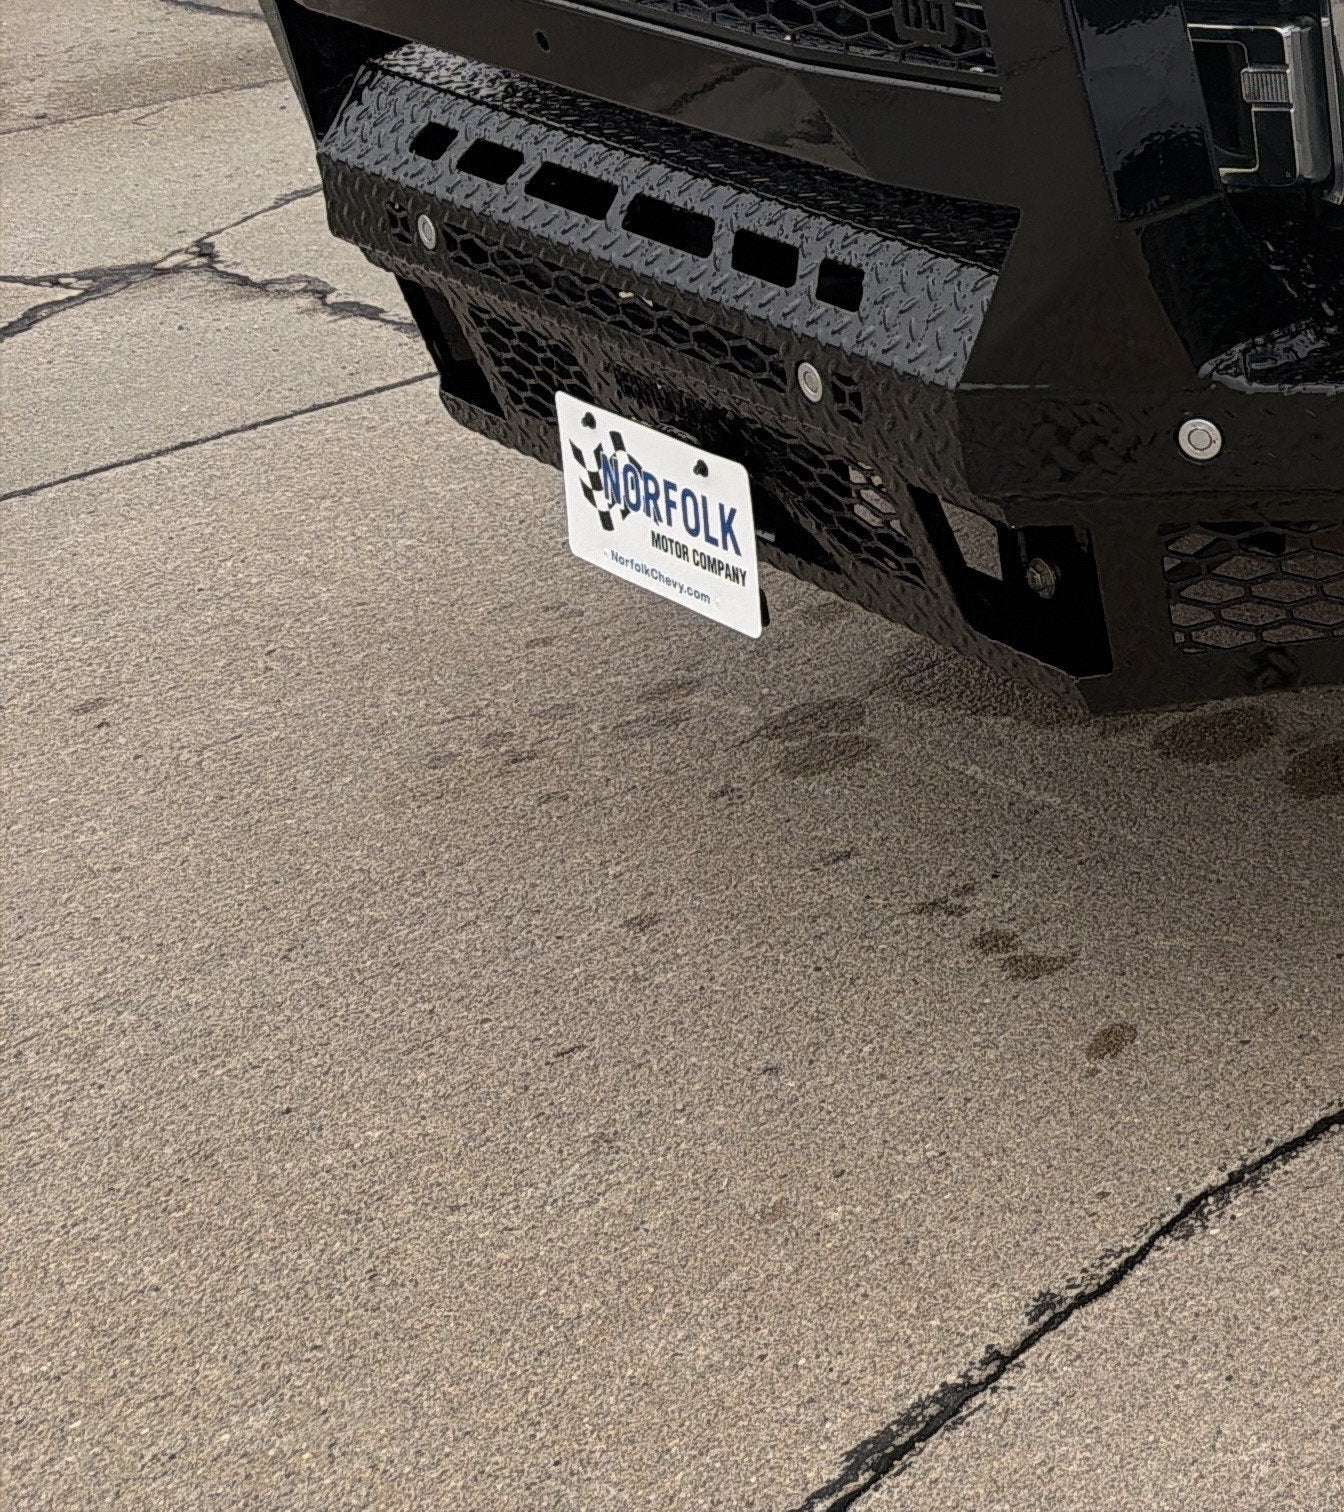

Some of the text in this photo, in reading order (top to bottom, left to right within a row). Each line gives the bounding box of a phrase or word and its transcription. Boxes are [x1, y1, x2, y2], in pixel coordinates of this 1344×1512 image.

[601, 452, 742, 557] NORFOLK
[611, 550, 711, 604] NorfolkChevy.com
[651, 530, 747, 588] MOTOR COMPANY
